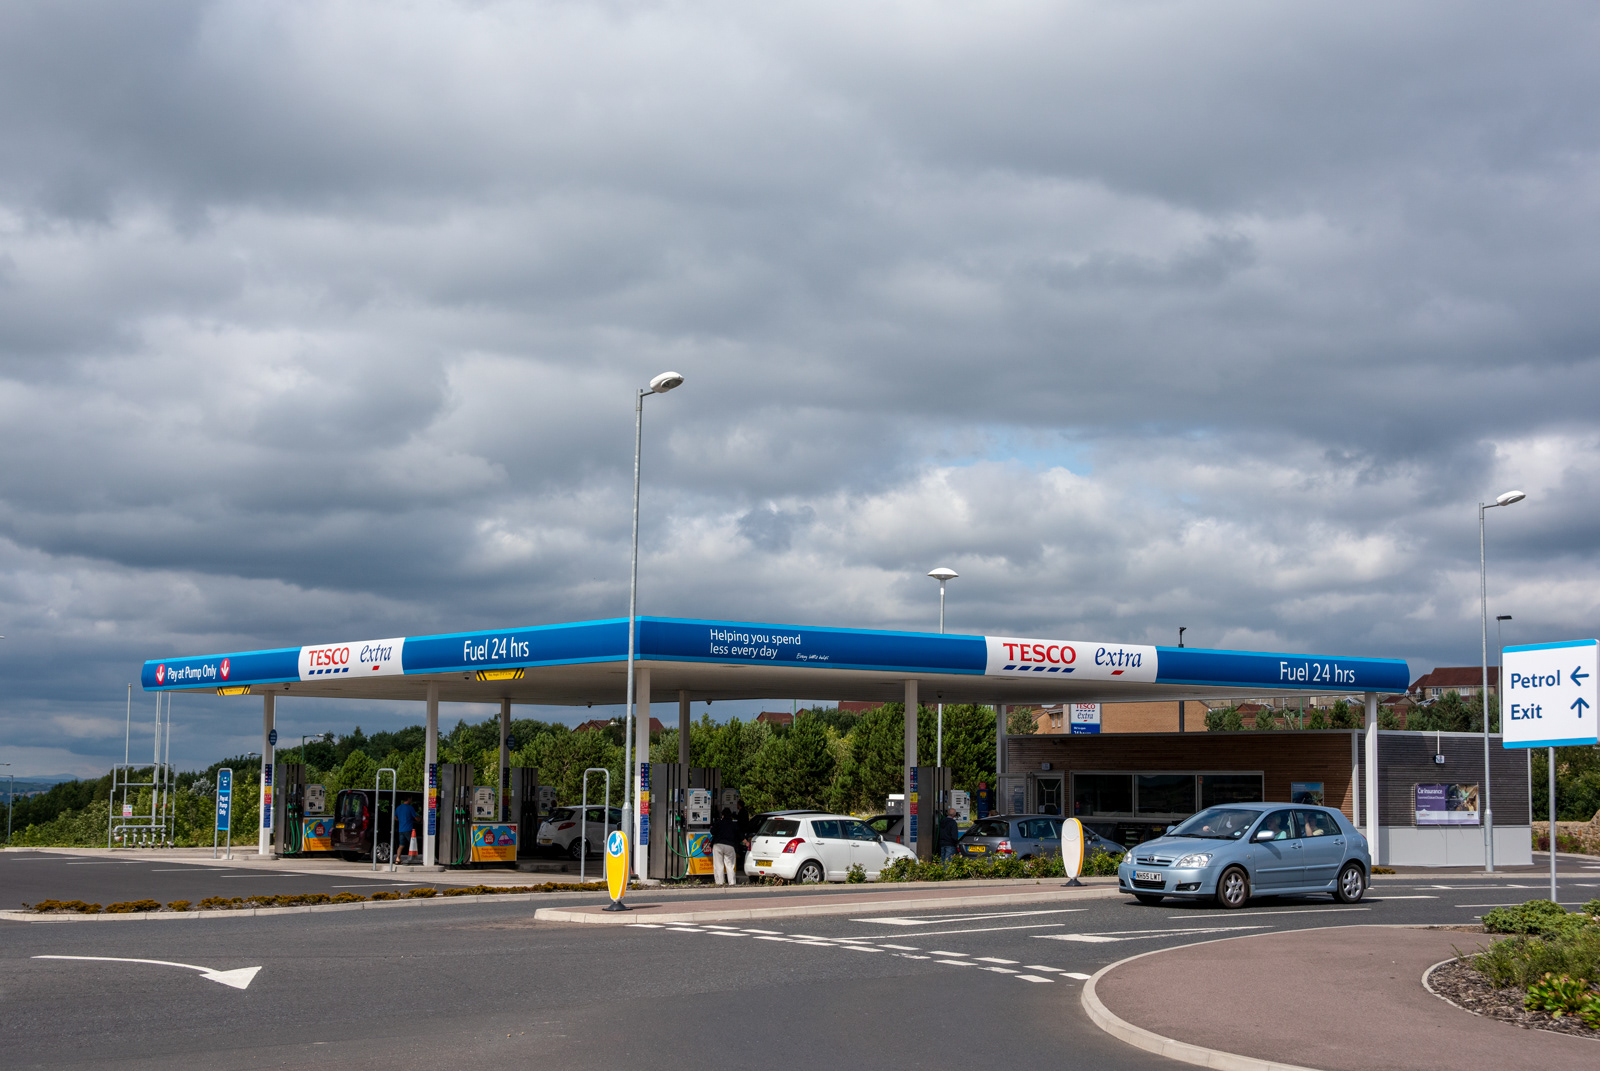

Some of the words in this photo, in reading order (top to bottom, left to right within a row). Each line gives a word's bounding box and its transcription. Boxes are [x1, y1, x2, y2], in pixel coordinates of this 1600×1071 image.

[710, 629, 749, 645] Helping
[751, 634, 769, 645] you
[772, 634, 801, 646] spend
[308, 647, 350, 666] TESCO
[360, 644, 392, 662] extra
[464, 639, 488, 661] Fuel
[492, 638, 506, 659] 24
[510, 637, 529, 658] hrs
[710, 642, 728, 654] less
[732, 647, 758, 658] every
[760, 646, 778, 660] day
[1003, 643, 1076, 664] TESCO
[1094, 648, 1142, 668] extra
[168, 668, 177, 682] Pay
[178, 668, 184, 678] at
[185, 666, 202, 680] Pump
[202, 664, 216, 679] Only
[1280, 662, 1308, 682] Fuel
[1313, 663, 1330, 682] 24
[1334, 664, 1355, 683] hrs
[1511, 670, 1560, 689] Petrol
[1511, 704, 1542, 720] Exit
